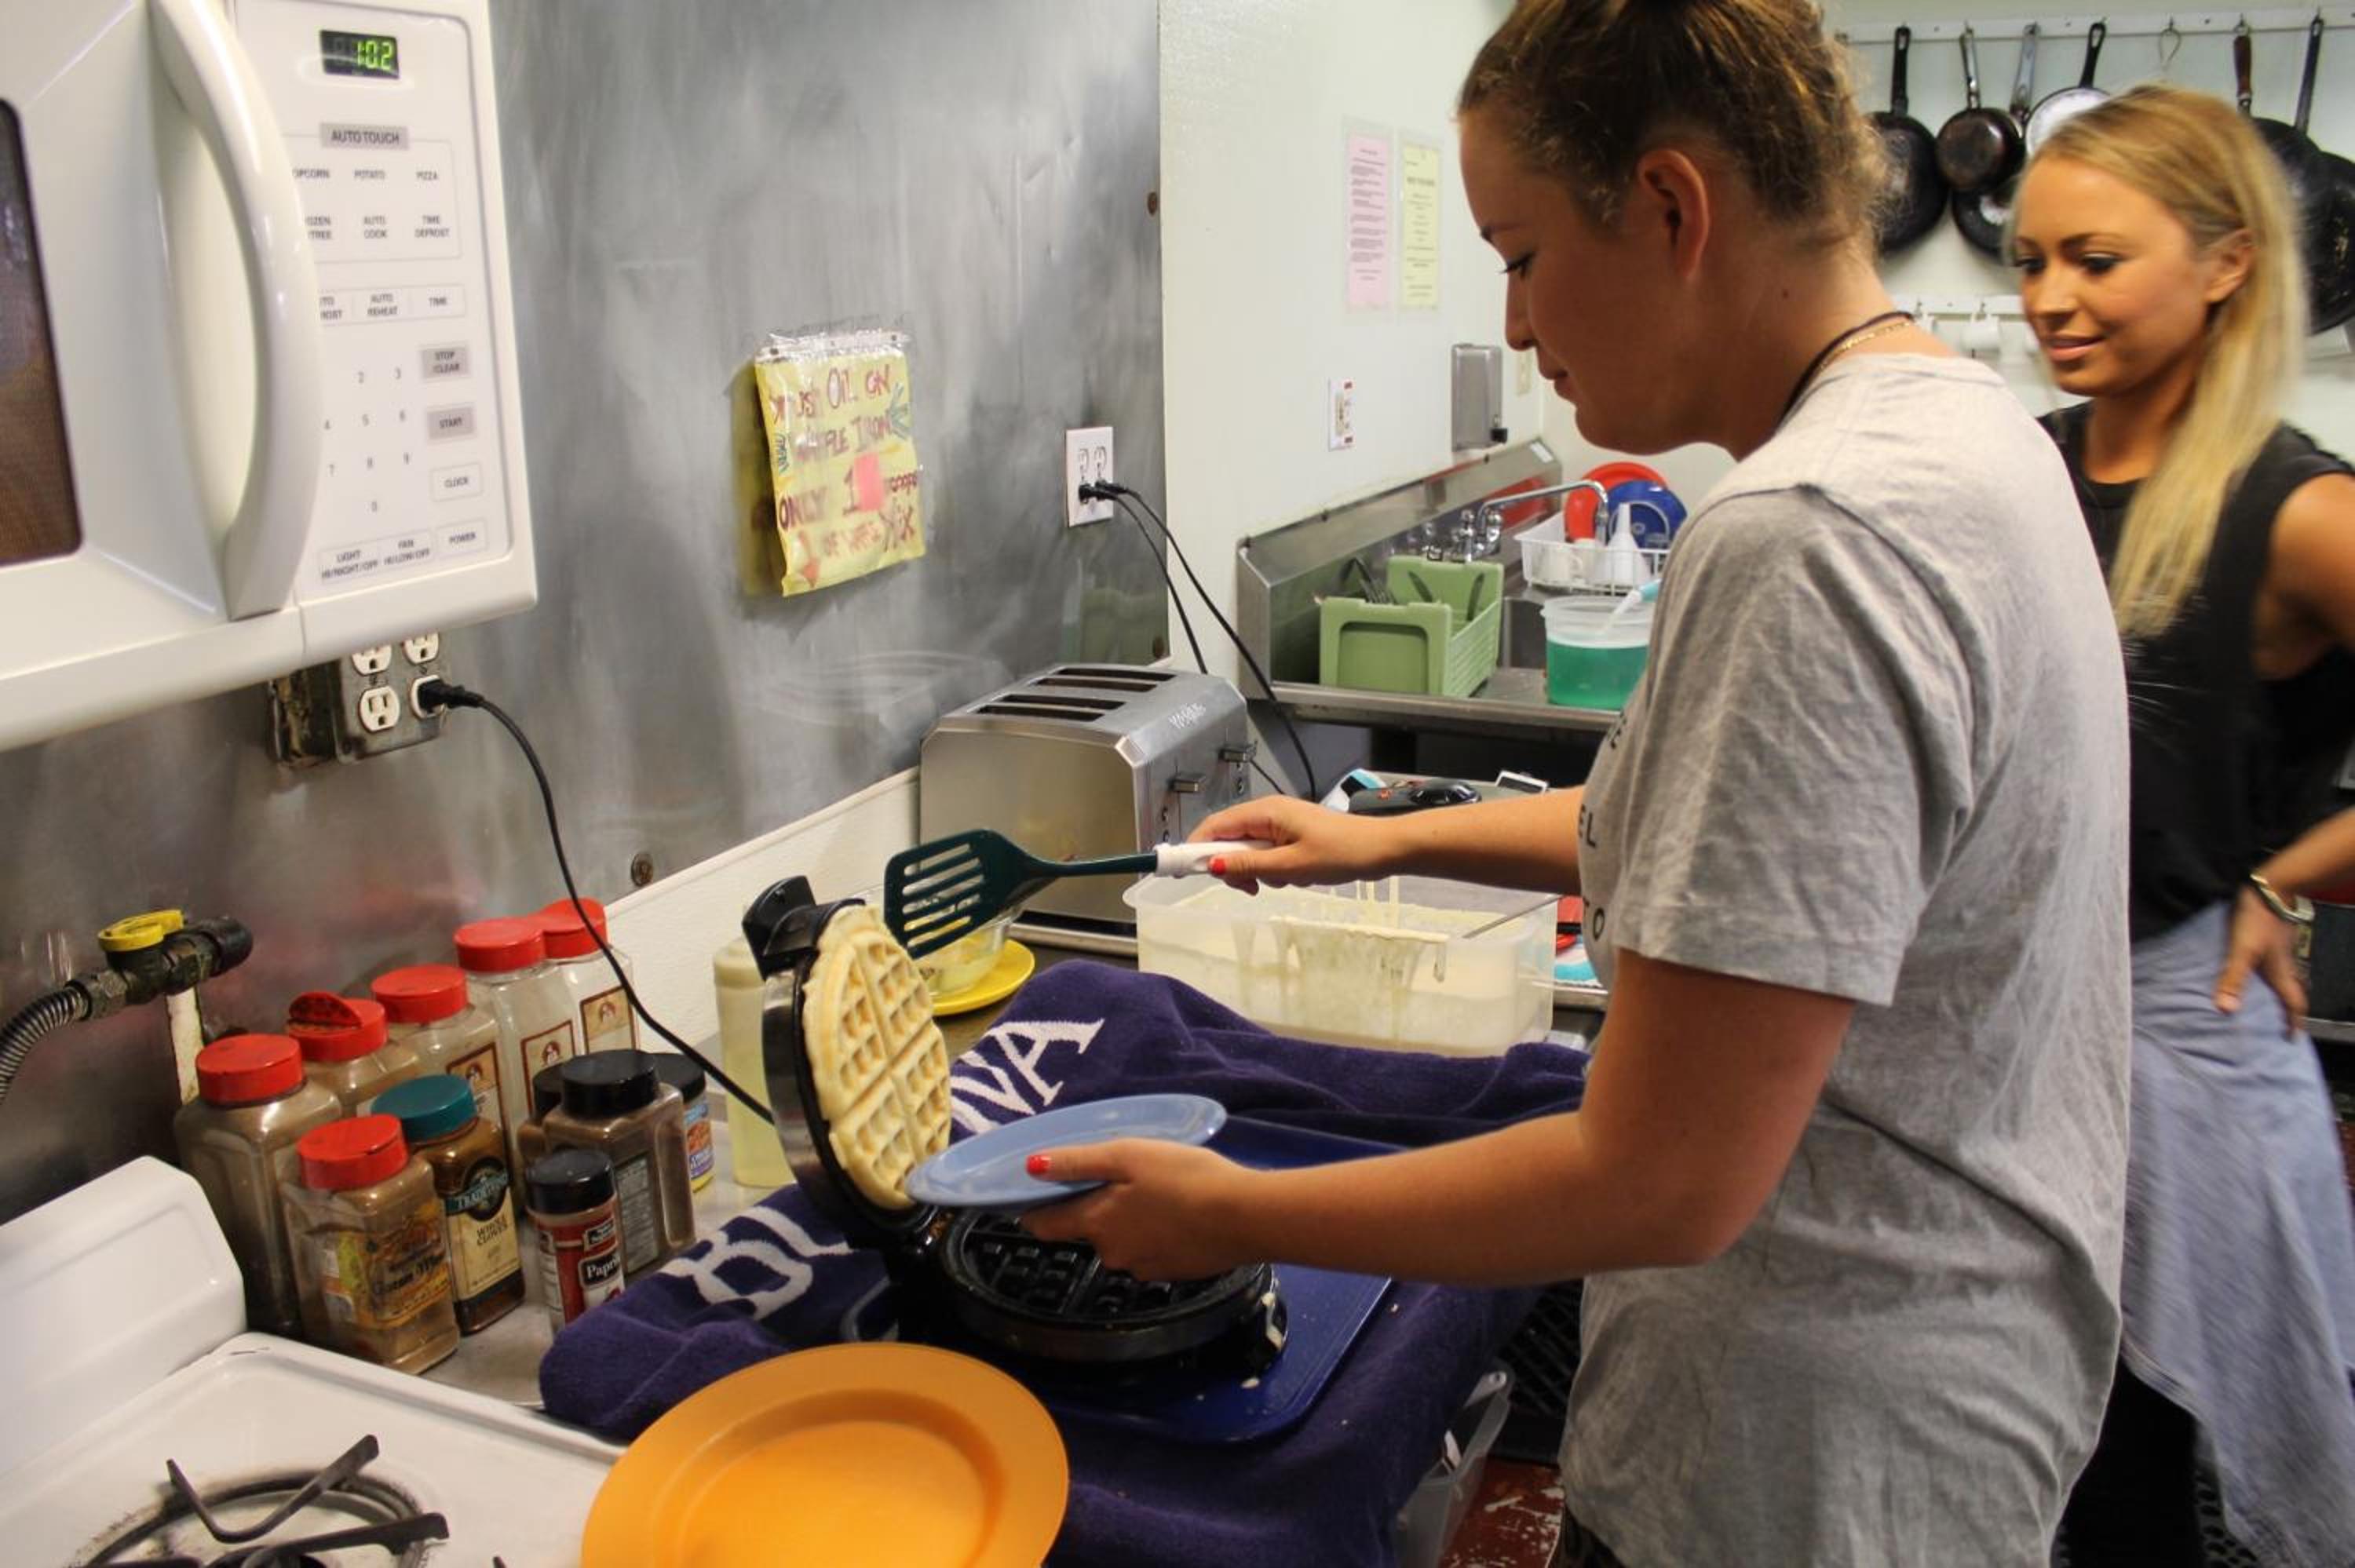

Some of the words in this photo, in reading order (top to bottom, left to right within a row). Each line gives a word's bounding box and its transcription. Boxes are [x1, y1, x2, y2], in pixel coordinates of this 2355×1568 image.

[331, 129, 362, 144] AUTO
[363, 130, 400, 145] TOUCH
[353, 169, 385, 180] POTATO
[415, 170, 438, 181] PIZZA
[363, 215, 386, 225] AUTO
[422, 215, 440, 224] TIME
[363, 229, 388, 239] COOK
[414, 228, 450, 239] DEFROST
[371, 294, 393, 304] AUTO
[429, 297, 447, 307] TIME
[367, 306, 399, 317] REHEAT
[435, 352, 456, 361] STOP
[433, 363, 461, 374] CLEAR
[439, 416, 463, 429] START
[444, 476, 469, 489] CLOCK
[448, 531, 476, 545] POWER
[398, 539, 414, 549] FAN
[336, 550, 361, 563] LIGHT
